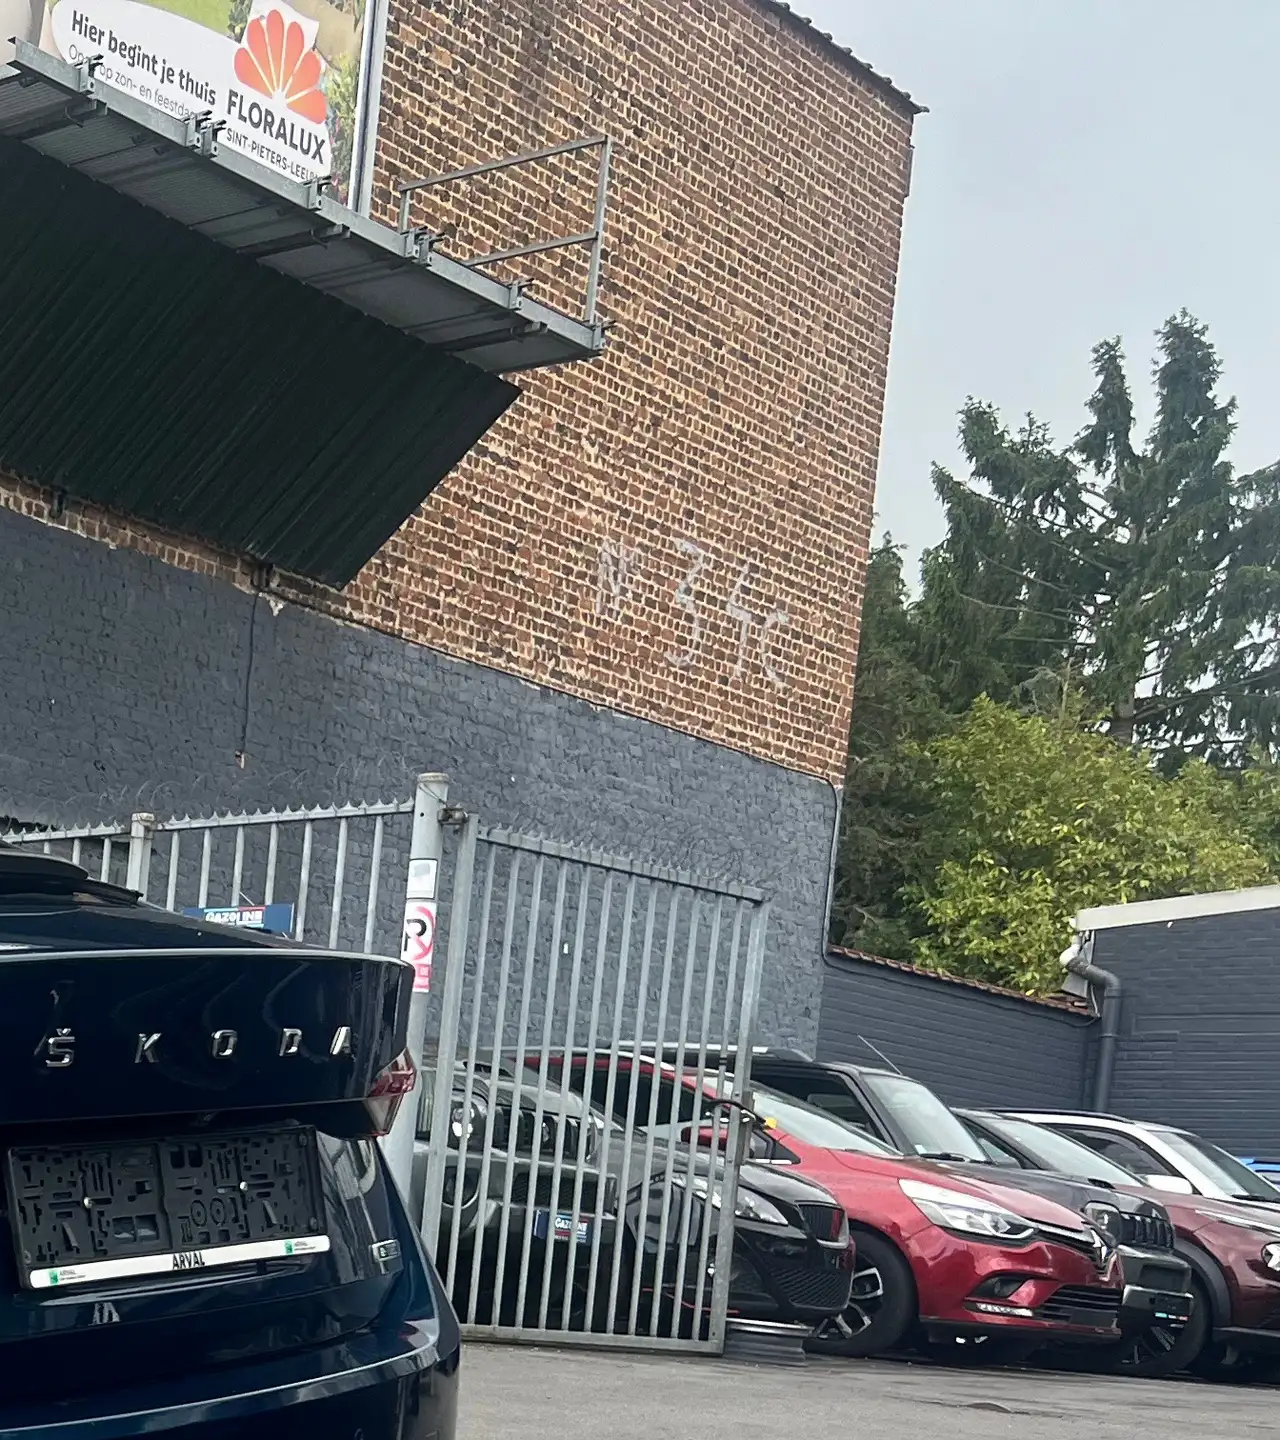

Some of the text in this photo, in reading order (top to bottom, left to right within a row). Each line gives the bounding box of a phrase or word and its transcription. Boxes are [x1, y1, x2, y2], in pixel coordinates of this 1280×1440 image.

[71, 9, 217, 106] Hier begint je thuis
[139, 84, 152, 100] en
[226, 88, 326, 165] FLORALUX
[171, 1251, 206, 1270] ARVAL
